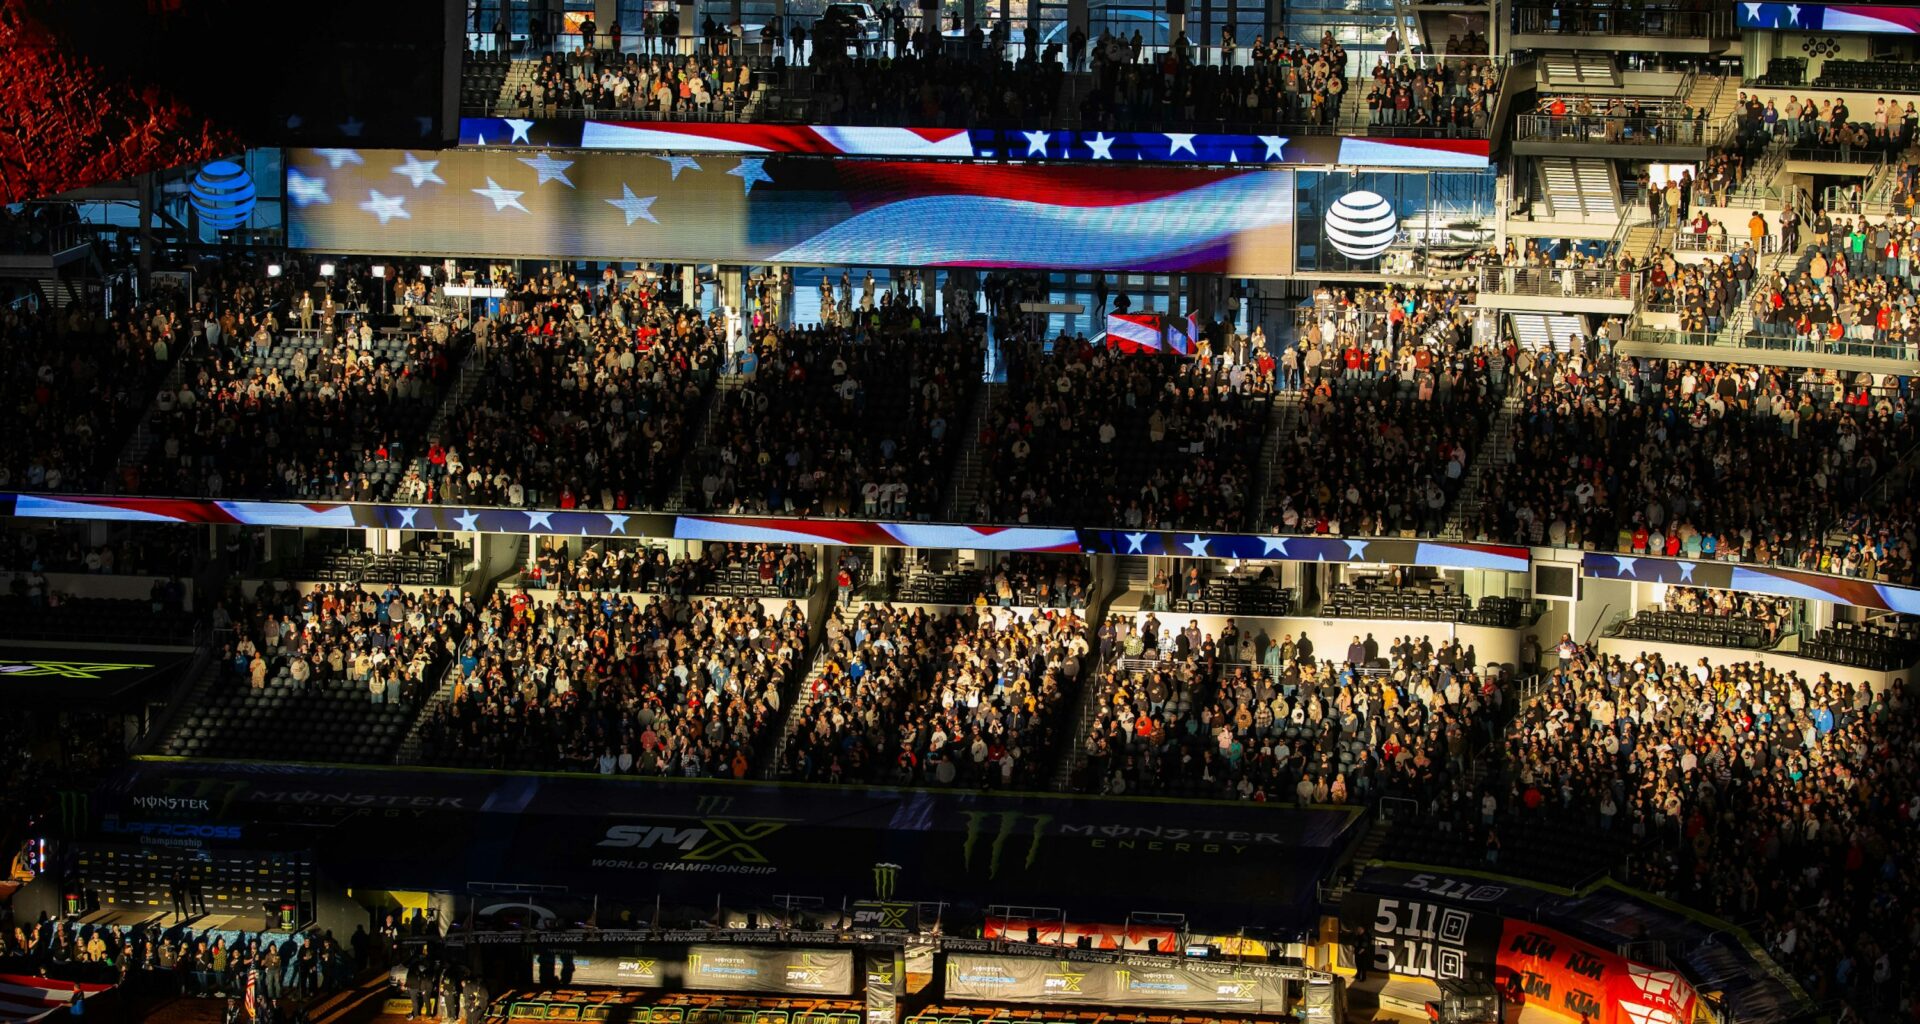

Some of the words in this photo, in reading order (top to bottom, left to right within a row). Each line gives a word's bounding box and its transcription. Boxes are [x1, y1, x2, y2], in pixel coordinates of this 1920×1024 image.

[133, 795, 209, 811] MONSTER
[251, 789, 464, 809] MONSTER
[102, 820, 242, 838] SUPERCROSS
[1060, 824, 1284, 844] MONSTER
[140, 836, 202, 848] Championship
[596, 819, 788, 864] SMX
[1091, 838, 1249, 855] ENERGY
[591, 858, 648, 870] WORLD
[652, 861, 778, 876] CHAMPIONSHIP
[1402, 873, 1473, 900] 5.11
[853, 907, 909, 929] SMX
[1374, 898, 1438, 940] 5.11
[1509, 930, 1558, 962] KTM
[618, 960, 655, 974] SMX
[1373, 936, 1437, 978] 5.11
[1563, 950, 1607, 981] KTM
[786, 969, 826, 984] SMX
[1044, 976, 1083, 991] SMX
[1506, 969, 1552, 1001] KTM
[1217, 983, 1255, 998] SMX
[1563, 987, 1601, 1020] KTM
